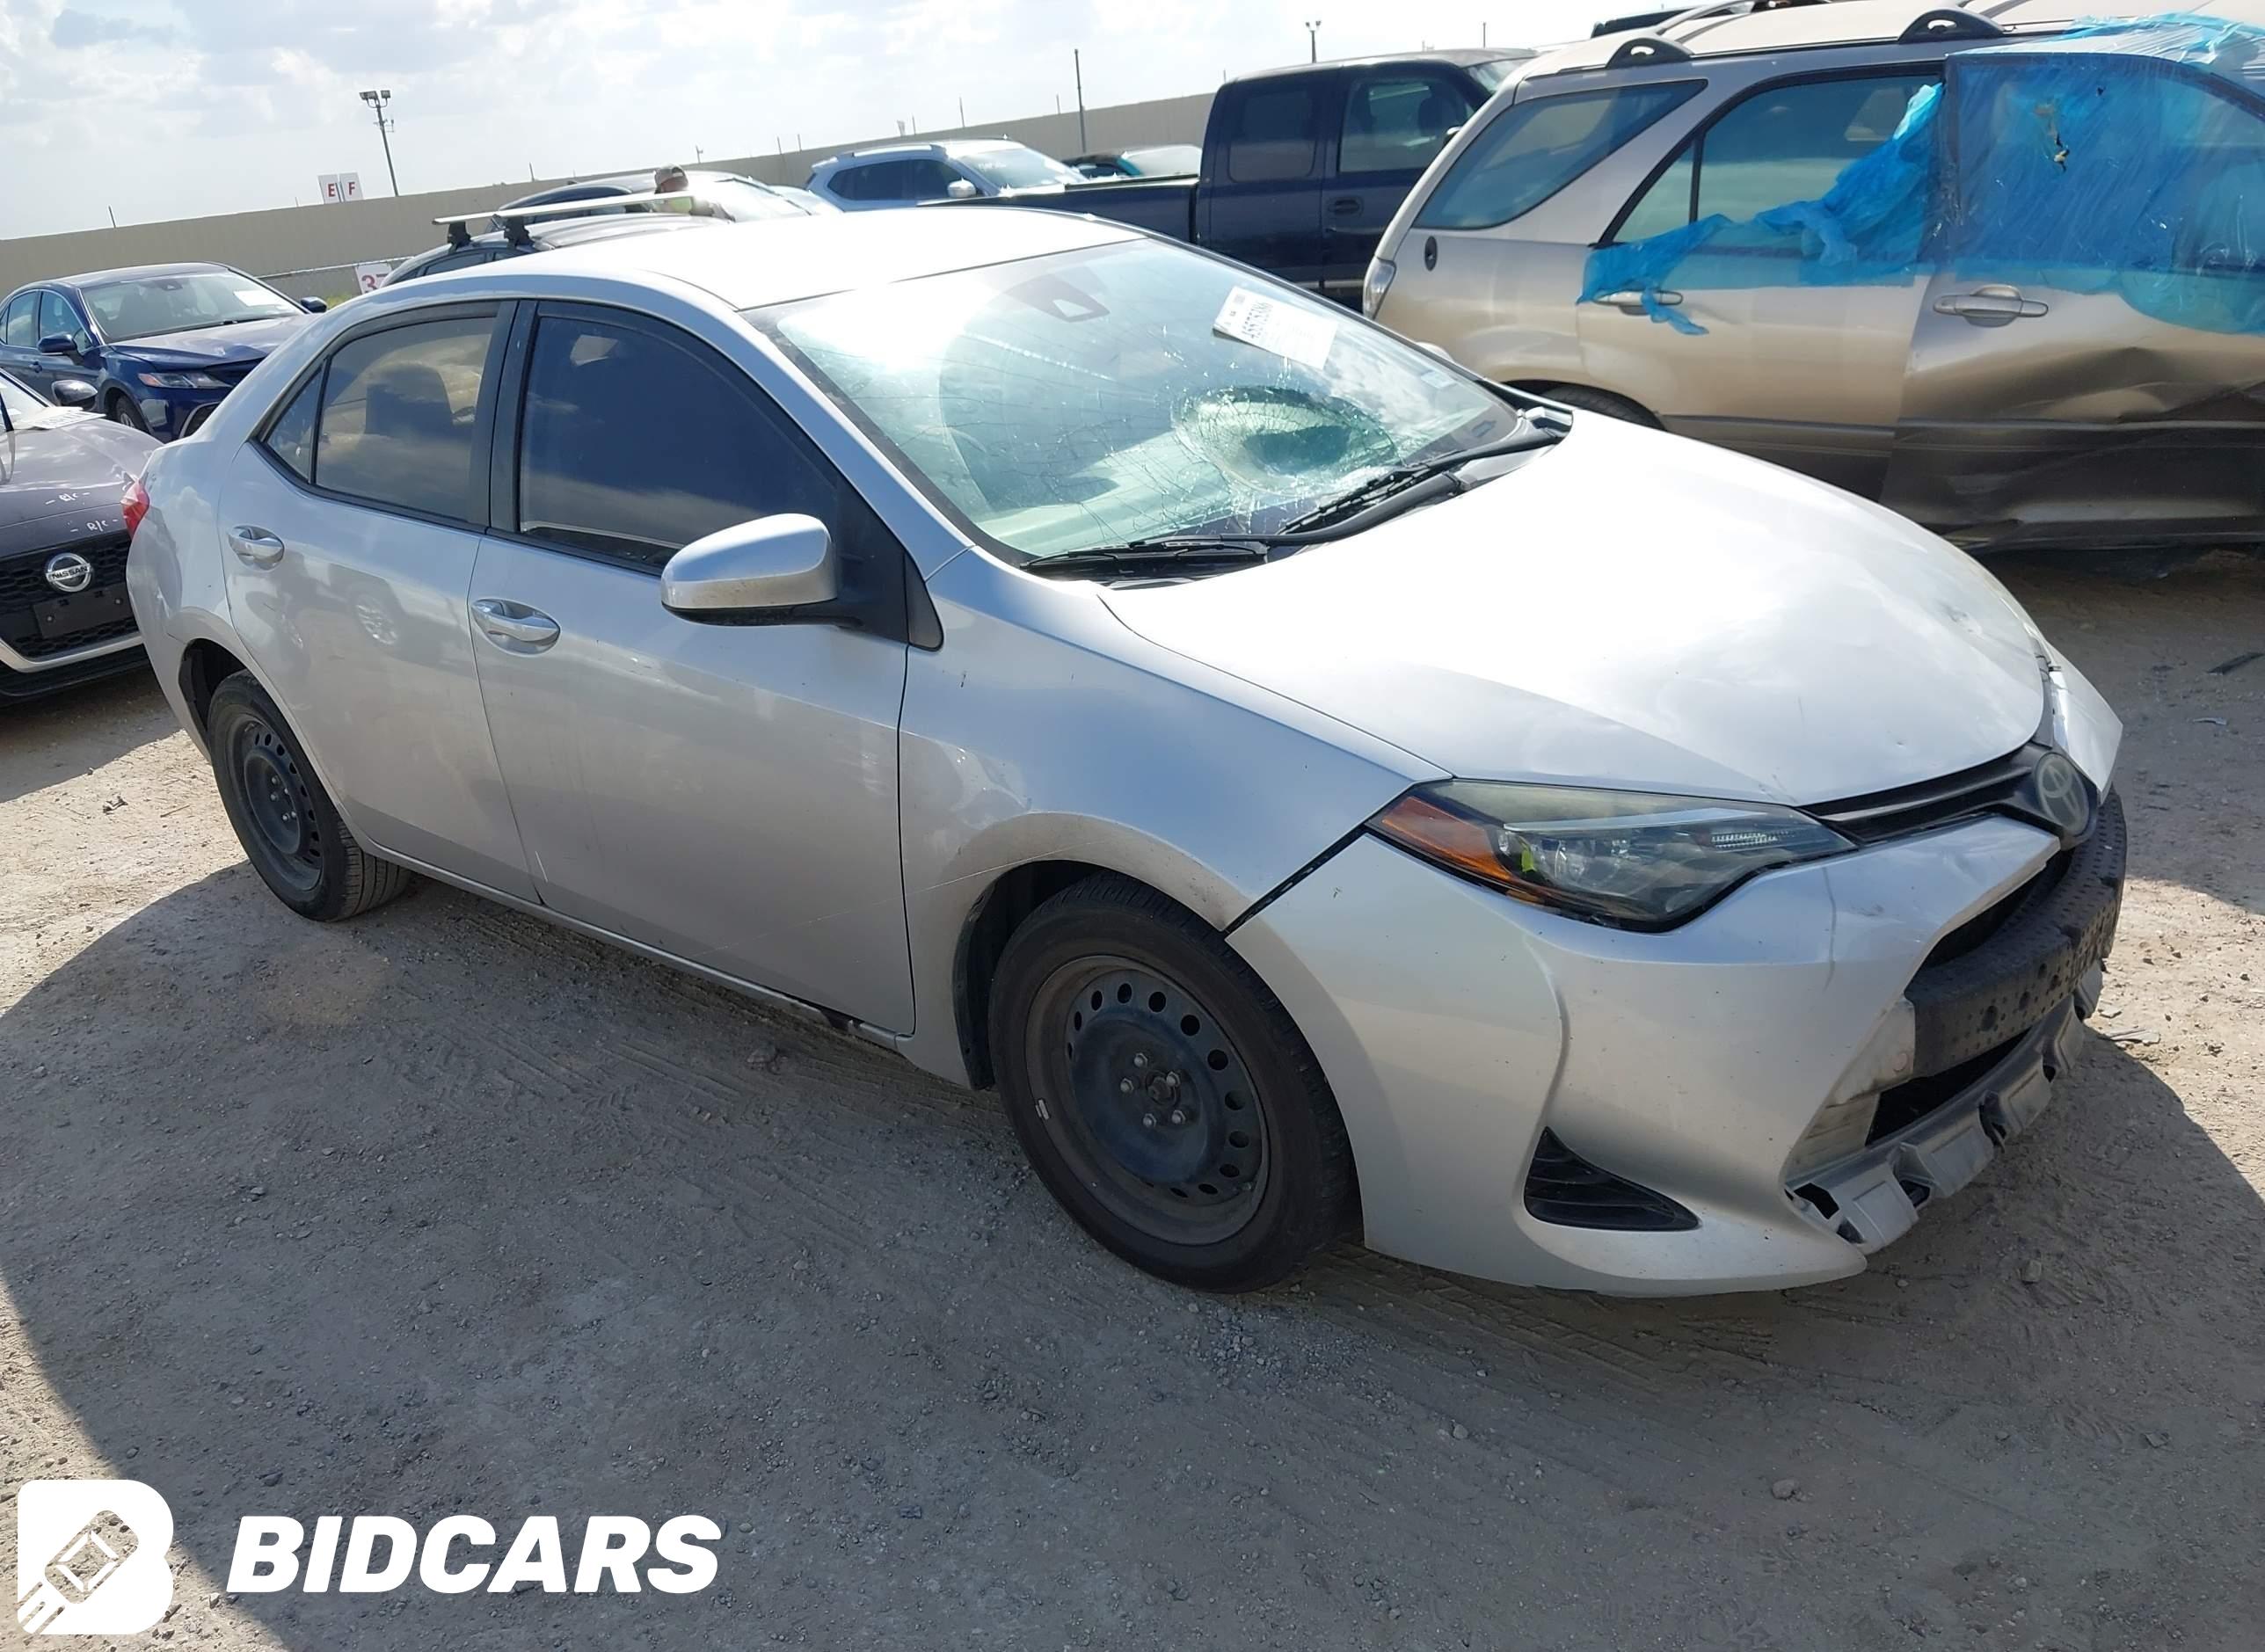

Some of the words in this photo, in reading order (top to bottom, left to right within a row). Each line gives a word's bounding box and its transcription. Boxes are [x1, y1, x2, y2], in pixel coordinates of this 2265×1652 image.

[328, 184, 336, 197] E
[348, 182, 355, 195] F
[52, 565, 88, 579] NISSAN
